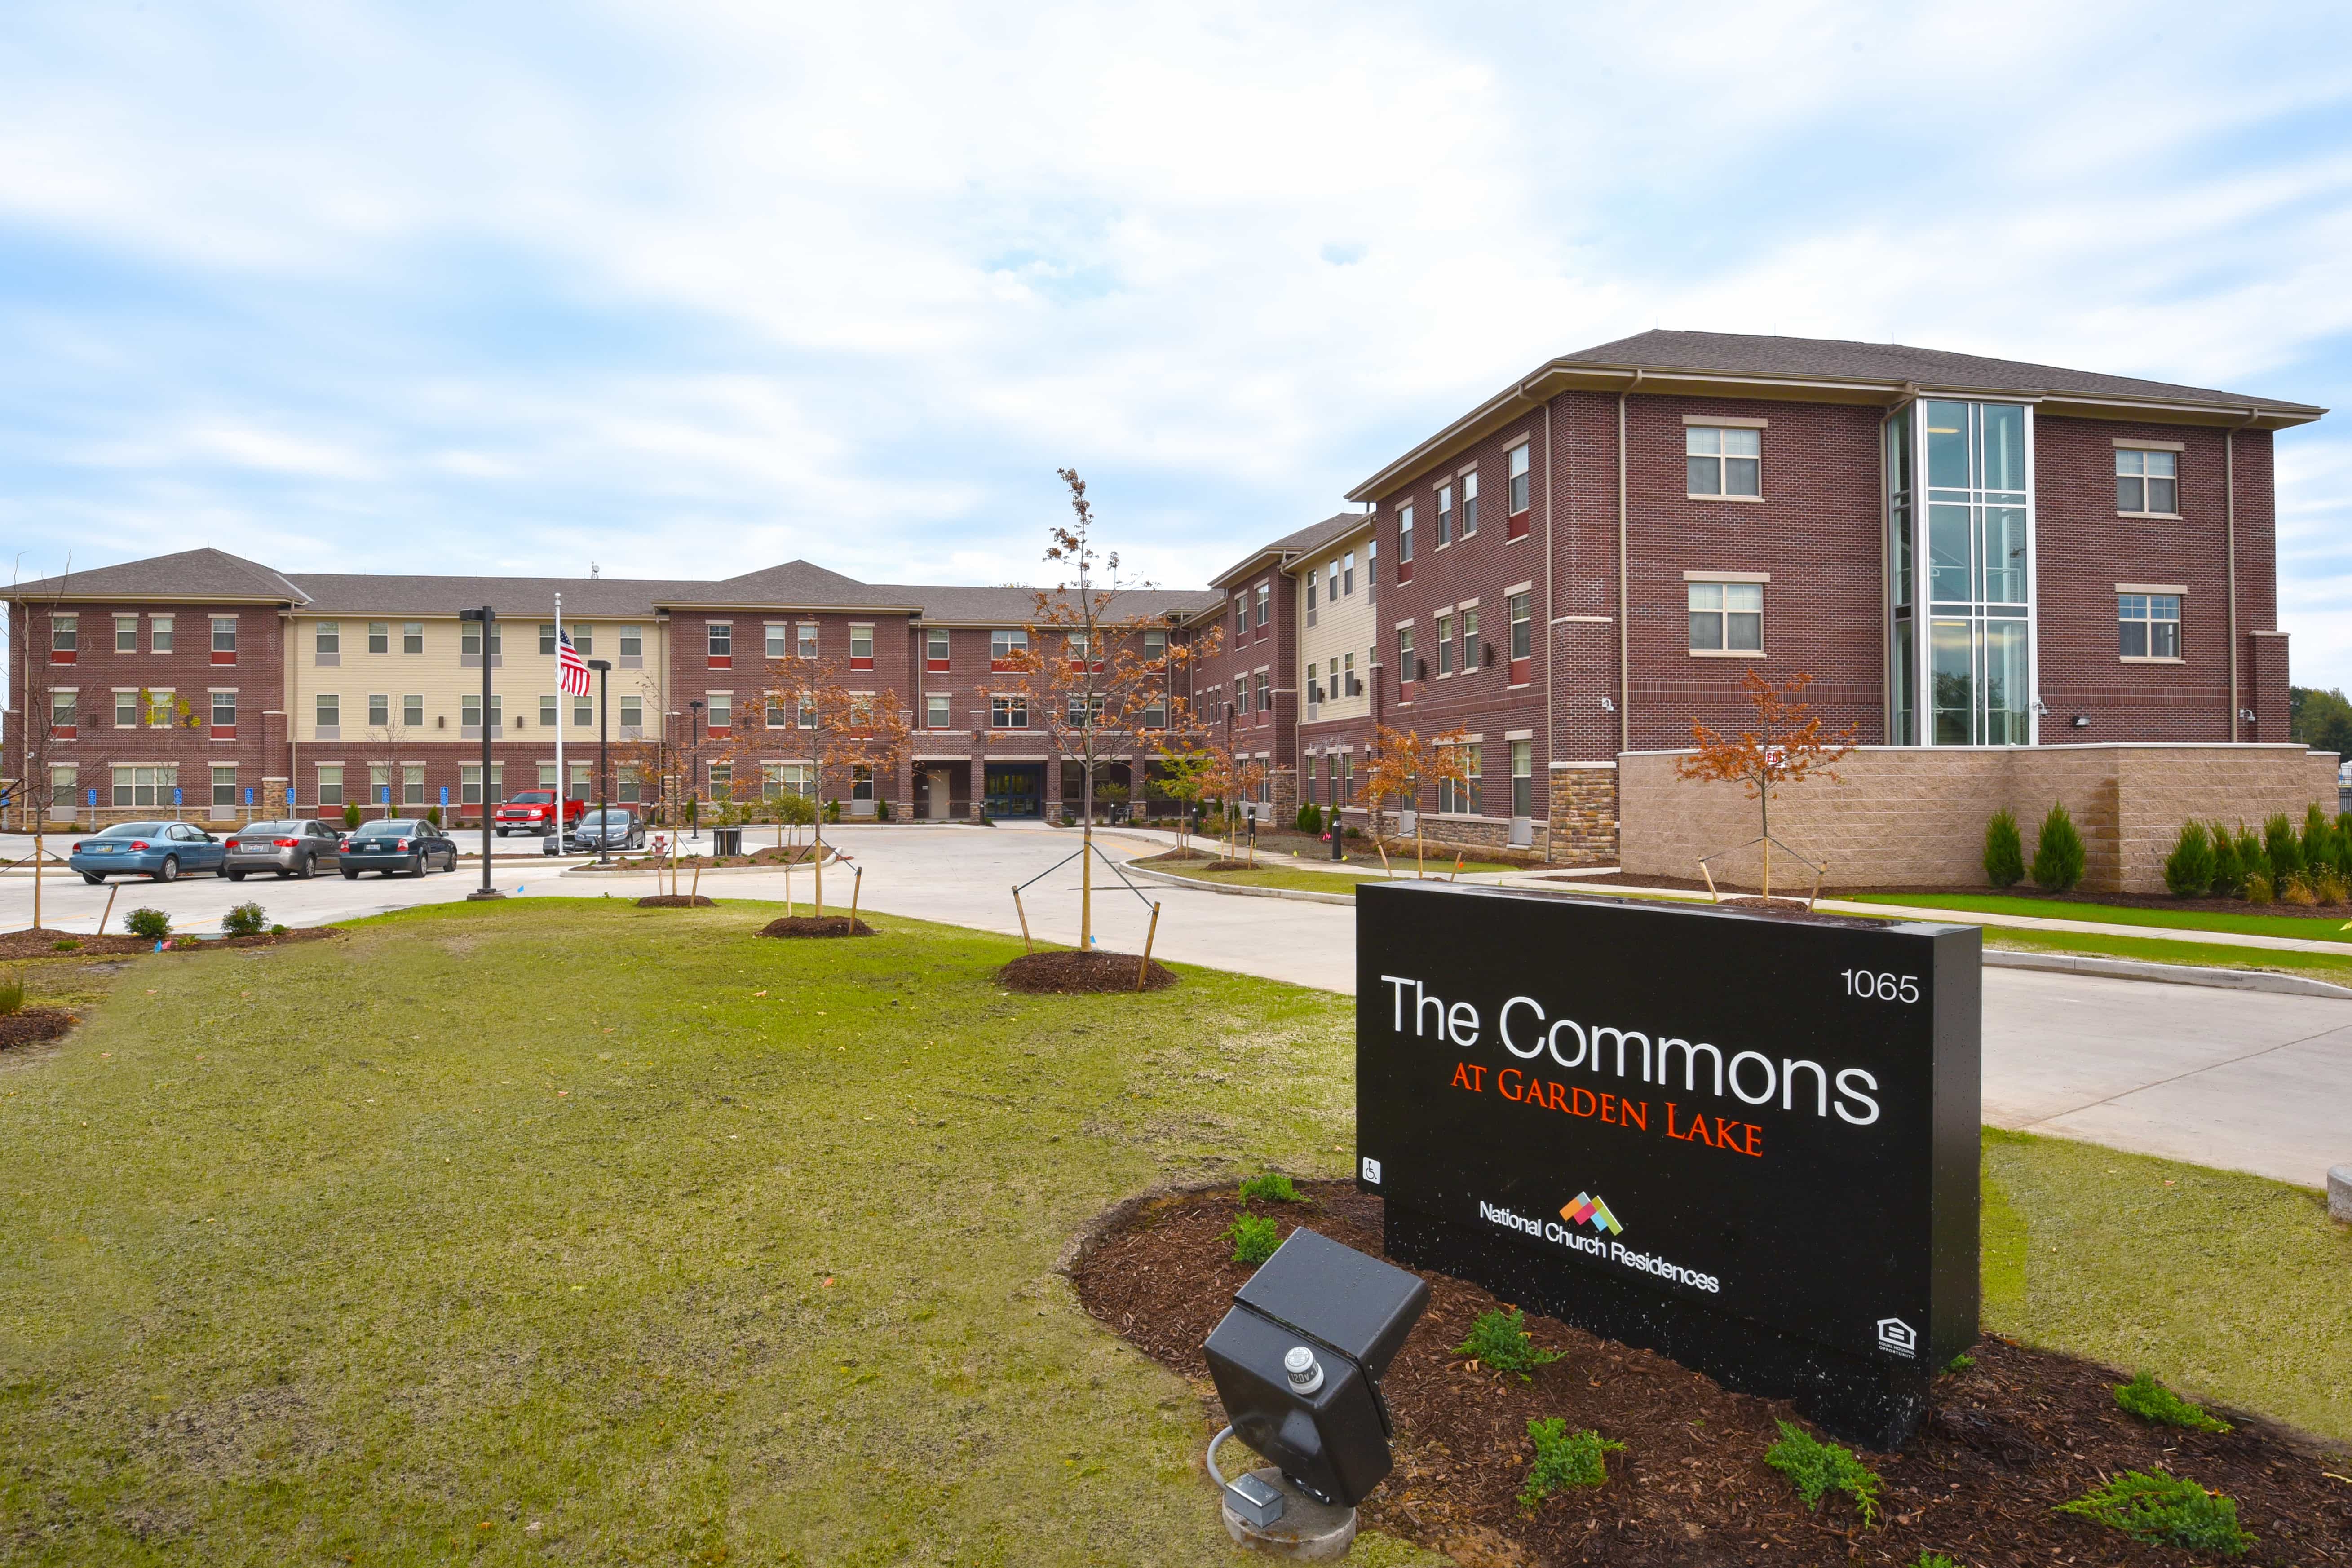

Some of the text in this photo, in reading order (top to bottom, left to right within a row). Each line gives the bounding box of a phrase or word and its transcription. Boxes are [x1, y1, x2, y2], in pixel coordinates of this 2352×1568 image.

[1841, 968, 1919, 1003] 1065
[1381, 975, 1880, 1125] The Commons
[1450, 1062, 1763, 1157] AT GARDEN LAKE
[1480, 1200, 1720, 1293] National Church Residences
[1879, 1346, 1914, 1360] OPPORTUNITY
[1893, 1345, 1914, 1355] HOUSING
